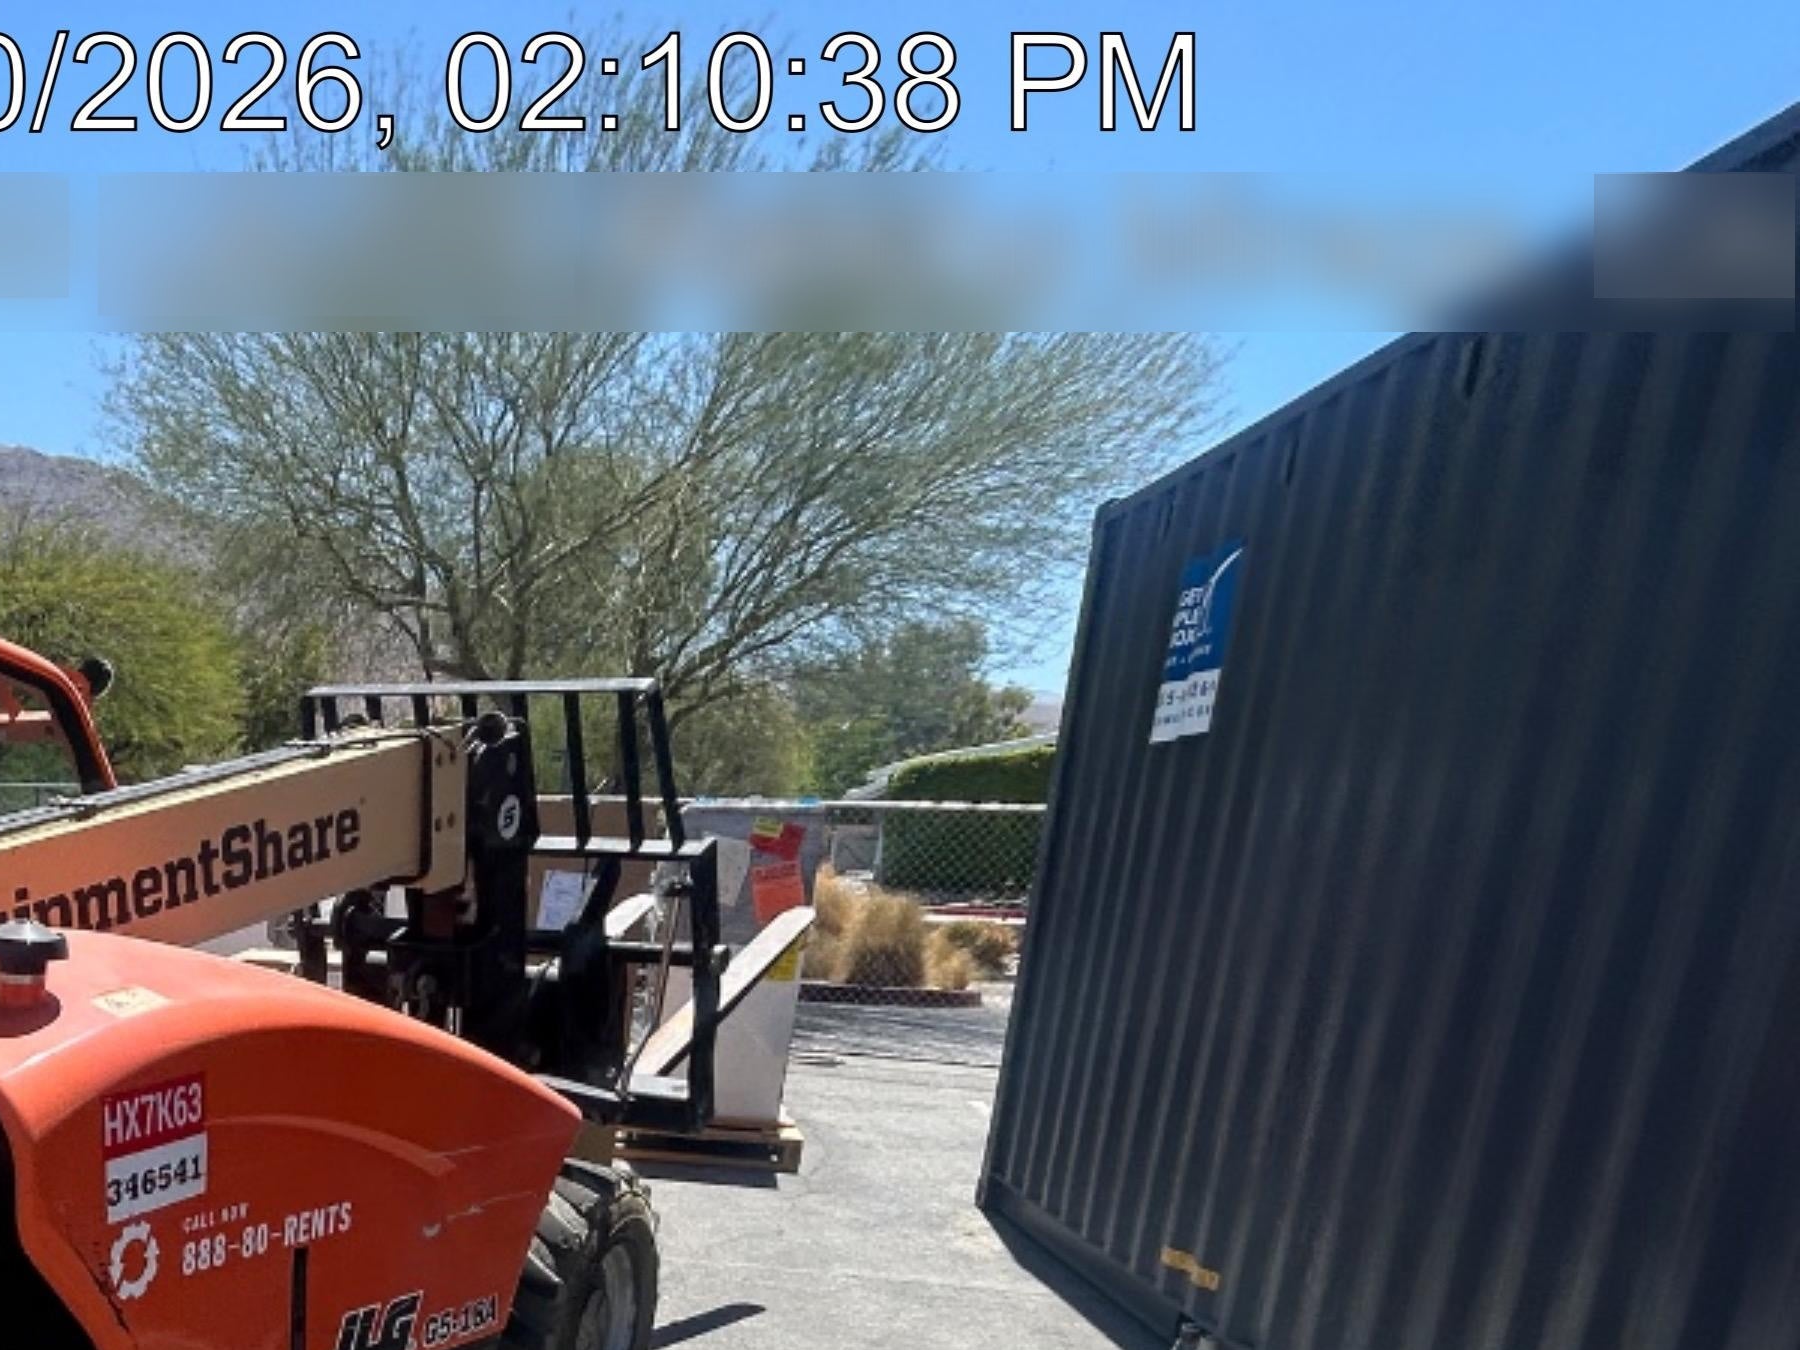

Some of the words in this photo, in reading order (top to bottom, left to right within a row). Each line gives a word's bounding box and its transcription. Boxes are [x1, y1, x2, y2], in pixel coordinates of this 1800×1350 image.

[104, 1081, 203, 1147] HX7K63
[107, 1154, 203, 1208] 346541
[182, 1210, 215, 1234] CALL
[221, 1202, 249, 1223] NOW
[182, 1201, 353, 1277] 888-80-RENTS
